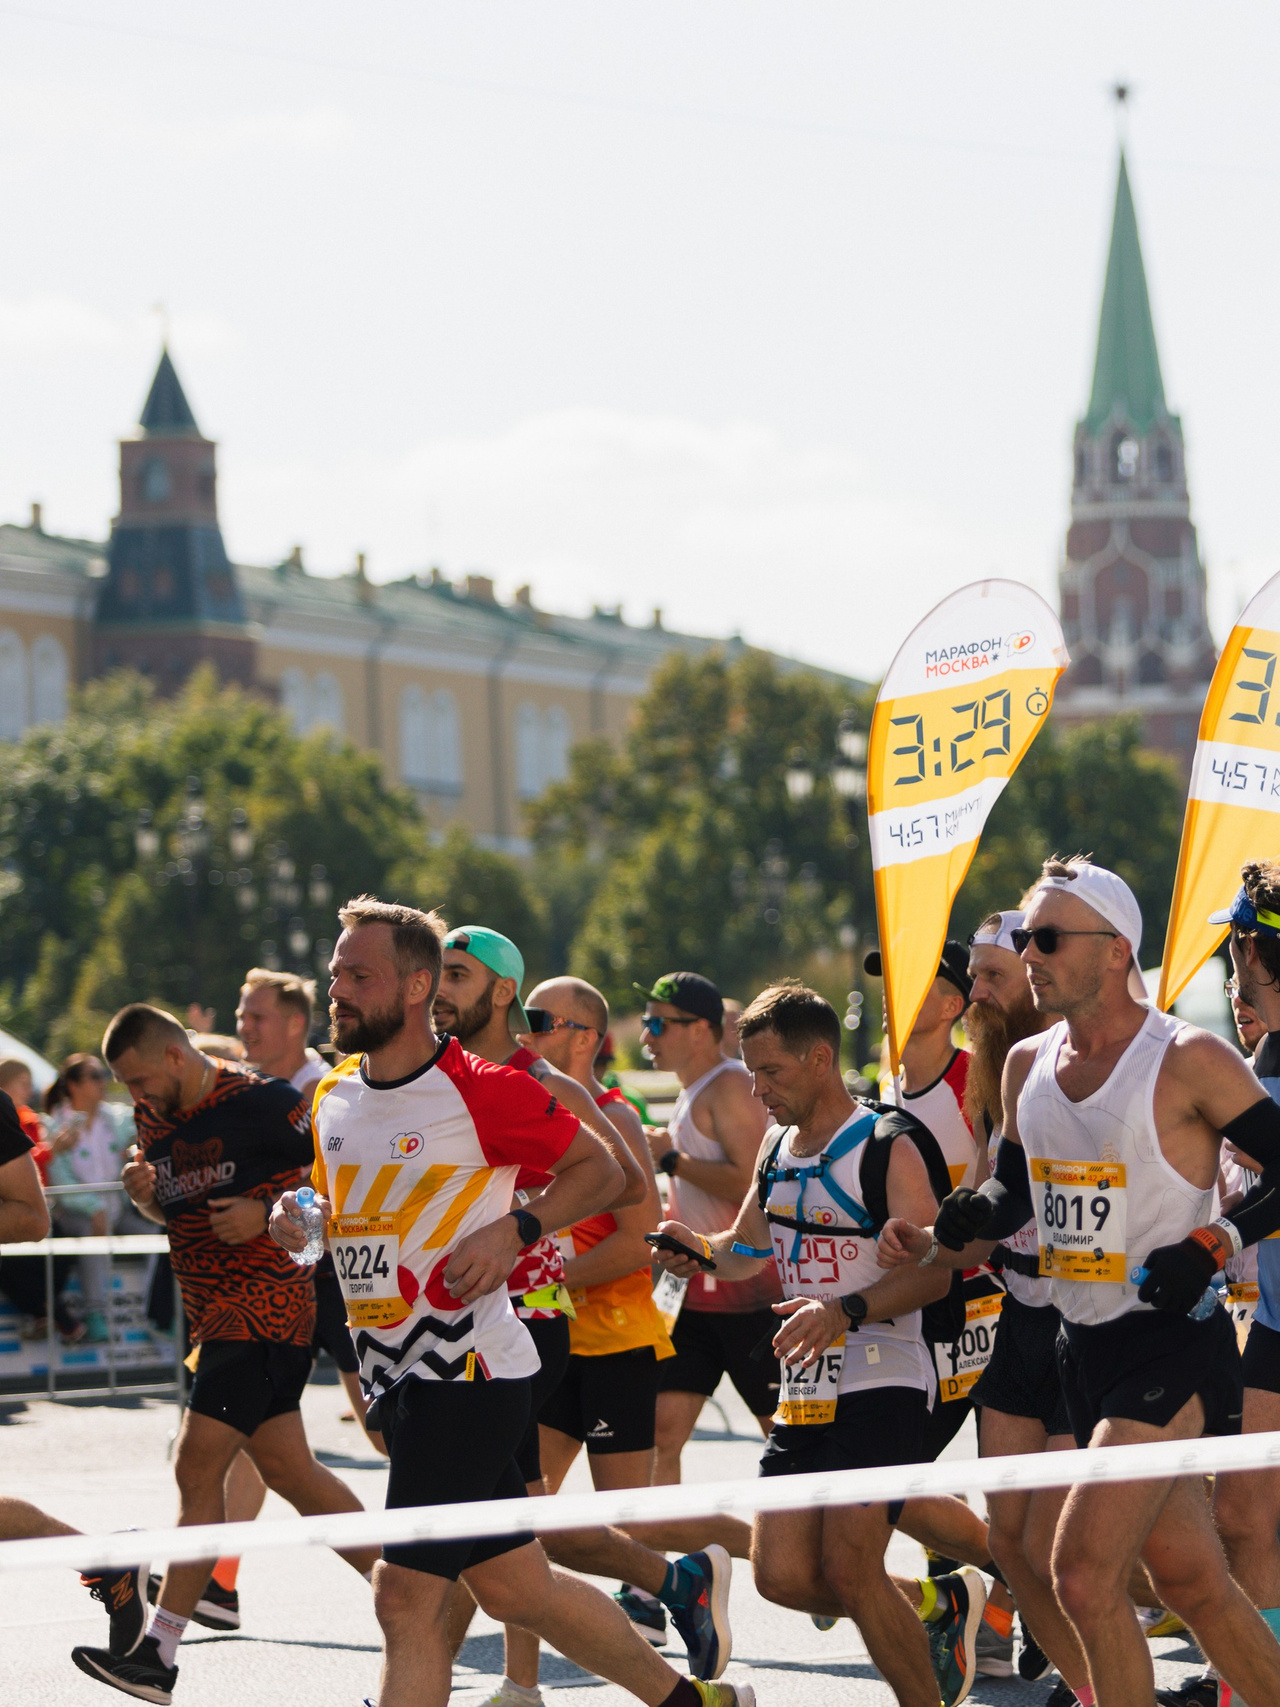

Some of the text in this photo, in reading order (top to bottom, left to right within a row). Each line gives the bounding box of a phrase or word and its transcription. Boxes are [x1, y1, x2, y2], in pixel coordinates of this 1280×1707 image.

[925, 637, 1002, 664] МАРАФОН
[926, 653, 989, 678] МОСКВА
[890, 689, 1010, 786] 3:29
[1212, 759, 1268, 791] 4:57
[889, 815, 940, 848] 4:57
[946, 821, 960, 838] КМ
[1052, 1164, 1087, 1174] МАРАФОН
[1052, 1173, 1078, 1181] МОСКВА
[340, 1217, 369, 1225] МАРАФОН
[1044, 1192, 1110, 1231] 8019
[1053, 1232, 1094, 1245] ВЛАДИМИР
[336, 1244, 390, 1280] 3224
[349, 1281, 374, 1294] ГЕОРГИЙ
[948, 1379, 958, 1395] D
